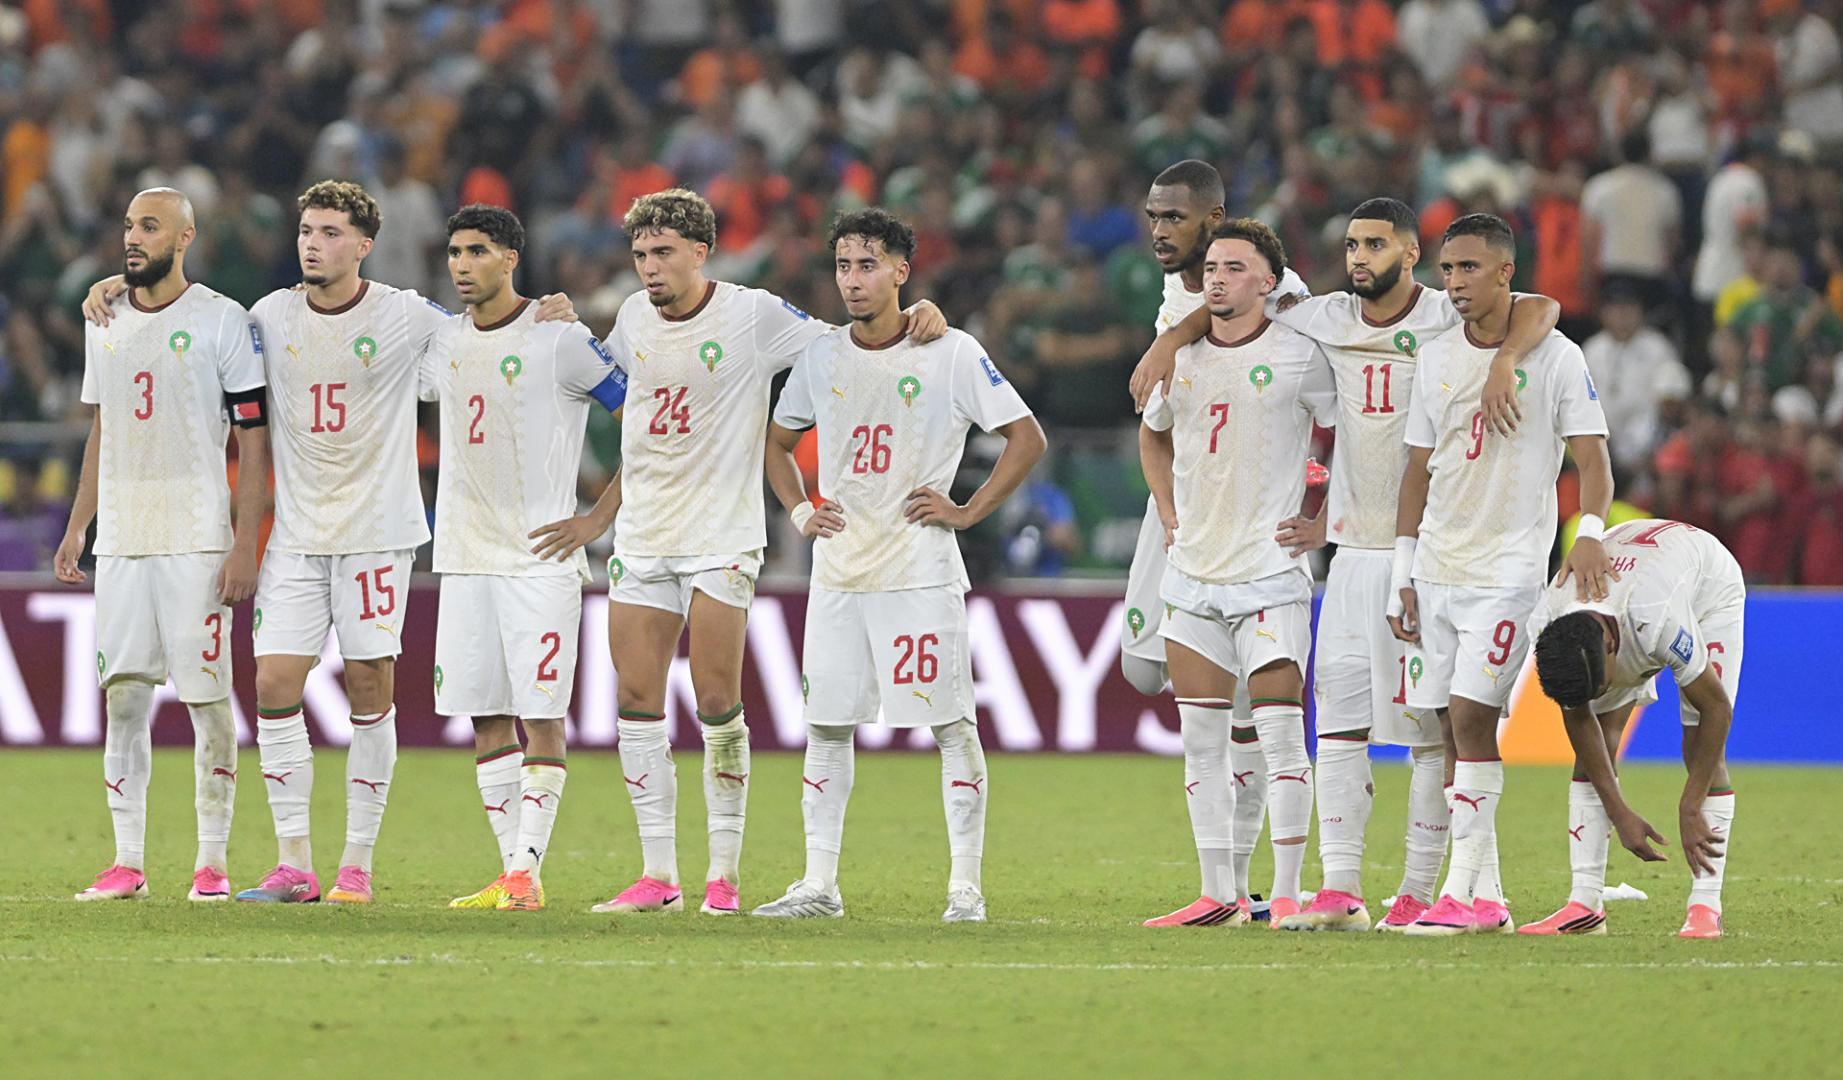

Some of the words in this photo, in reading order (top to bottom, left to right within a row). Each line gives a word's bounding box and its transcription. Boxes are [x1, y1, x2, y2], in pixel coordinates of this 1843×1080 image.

[134, 371, 154, 421] 3
[309, 383, 346, 433] 15
[648, 387, 691, 436] 24
[1362, 363, 1395, 414] 11
[468, 394, 485, 444] 2
[1209, 402, 1230, 454] 7
[1466, 411, 1485, 460] 9
[852, 423, 893, 475] 26
[1611, 556, 1637, 572] YA
[355, 565, 395, 621] 15
[202, 613, 222, 662] 3
[537, 631, 561, 681] 2
[893, 633, 939, 685] 26
[1487, 620, 1516, 666] 9
